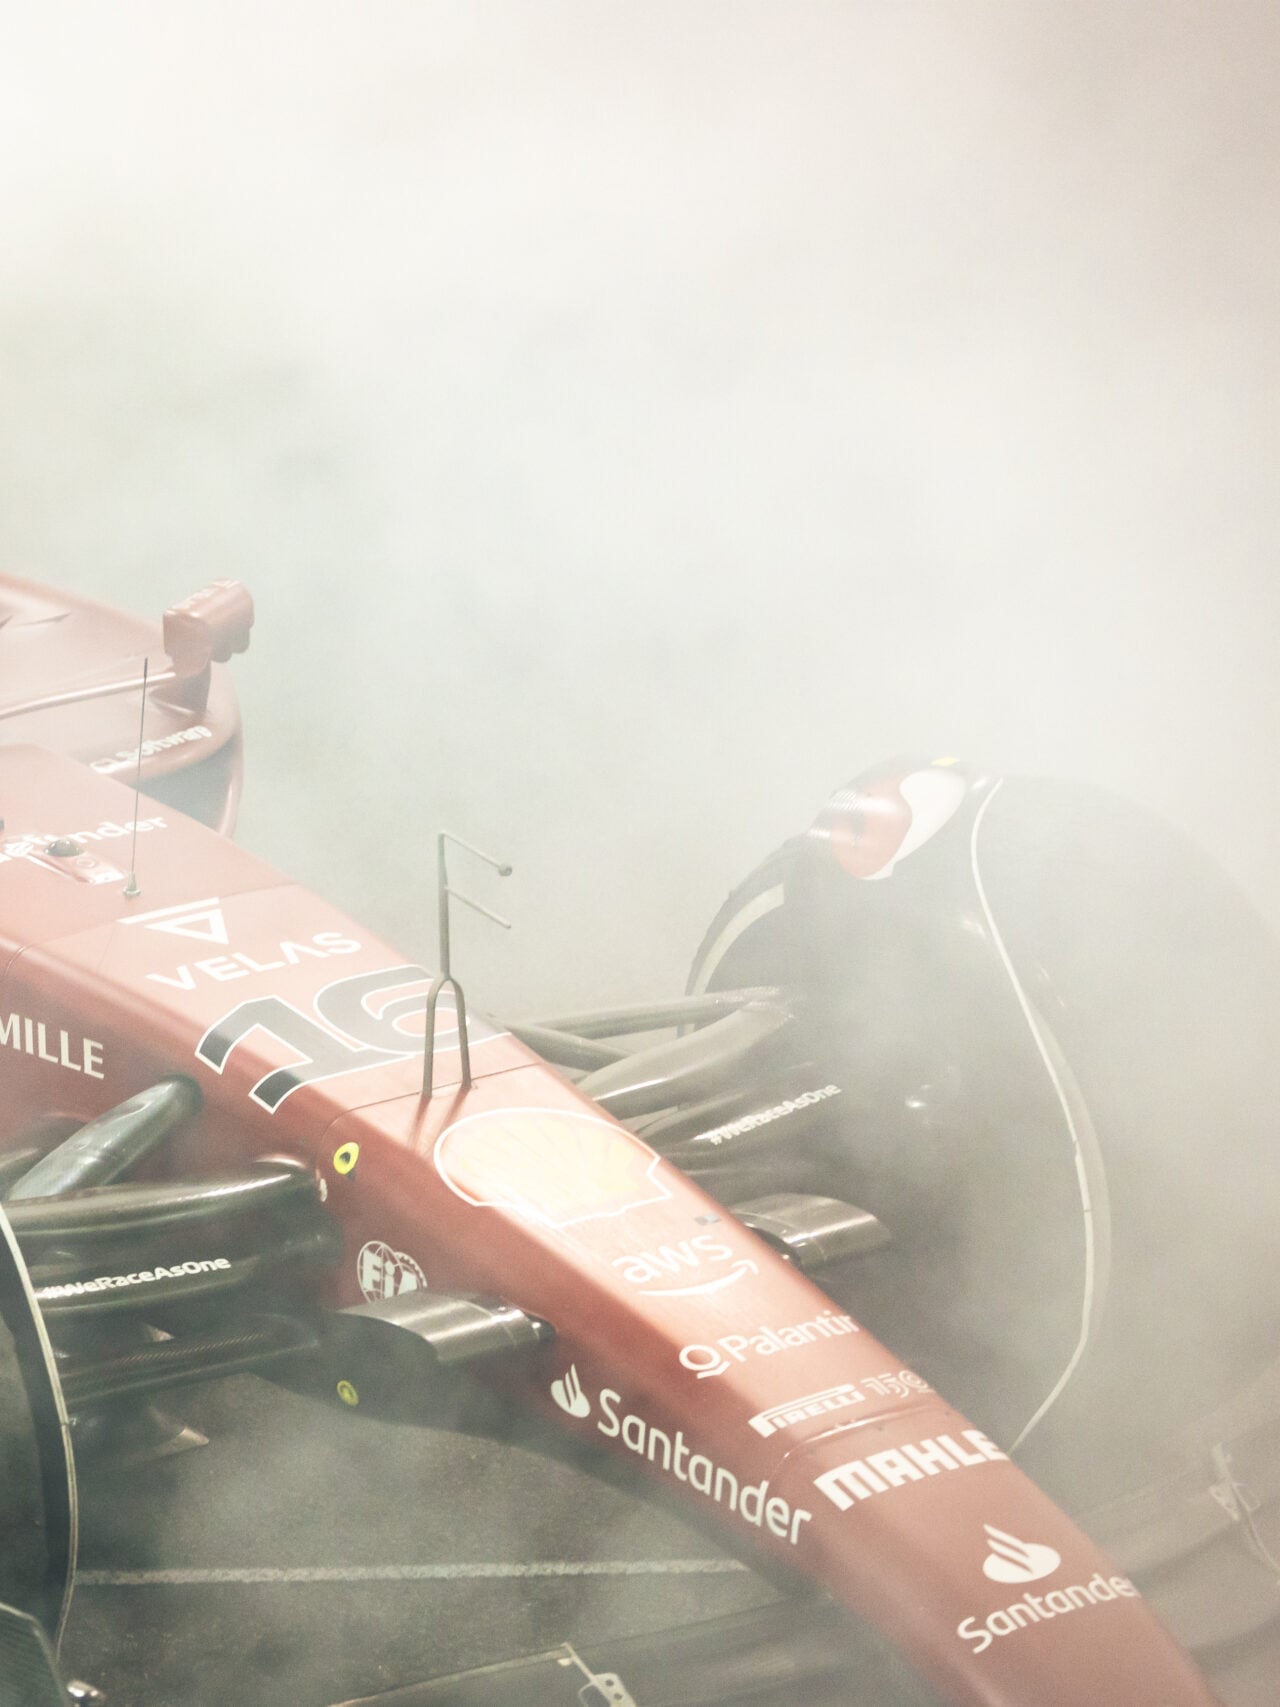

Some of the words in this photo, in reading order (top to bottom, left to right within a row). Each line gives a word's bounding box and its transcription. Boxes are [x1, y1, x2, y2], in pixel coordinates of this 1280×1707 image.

[145, 932, 362, 991] VELAS
[194, 964, 513, 1115] 16
[34, 1257, 231, 1299] #WeRaceAsOne
[611, 1234, 734, 1284] aws
[717, 1310, 860, 1362] Palantir
[748, 1383, 866, 1438] PIRELLI
[597, 1387, 813, 1545] Santander
[813, 1429, 1011, 1512] MAHLE
[957, 1572, 1142, 1653] Santande
